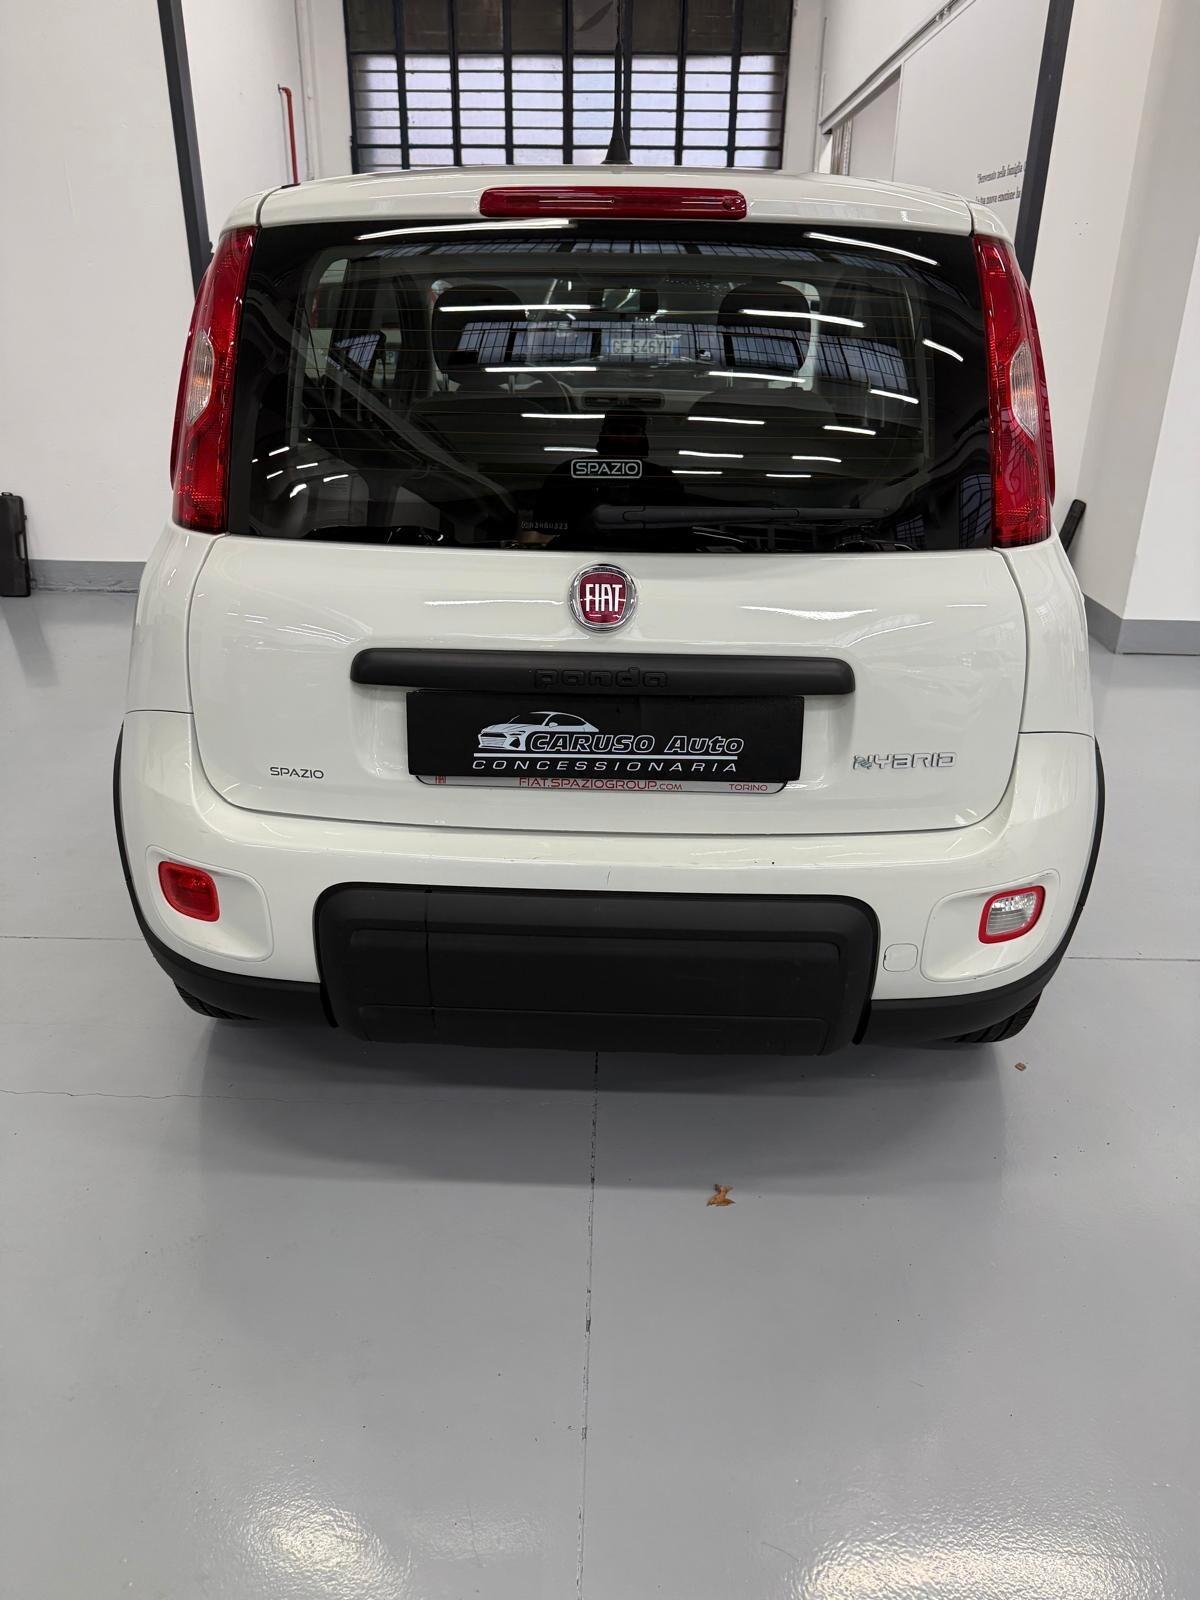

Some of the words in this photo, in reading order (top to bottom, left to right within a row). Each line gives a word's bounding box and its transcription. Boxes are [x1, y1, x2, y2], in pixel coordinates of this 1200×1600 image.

[575, 462, 639, 475] SPAZIO
[585, 583, 623, 612] FIAT
[534, 667, 669, 692] panda
[530, 733, 655, 754] CARUSO
[472, 760, 737, 773] CONCESSIONARIA
[852, 752, 958, 770] HYBRID
[269, 766, 325, 779] SPAZIO
[728, 783, 769, 792] TORINO
